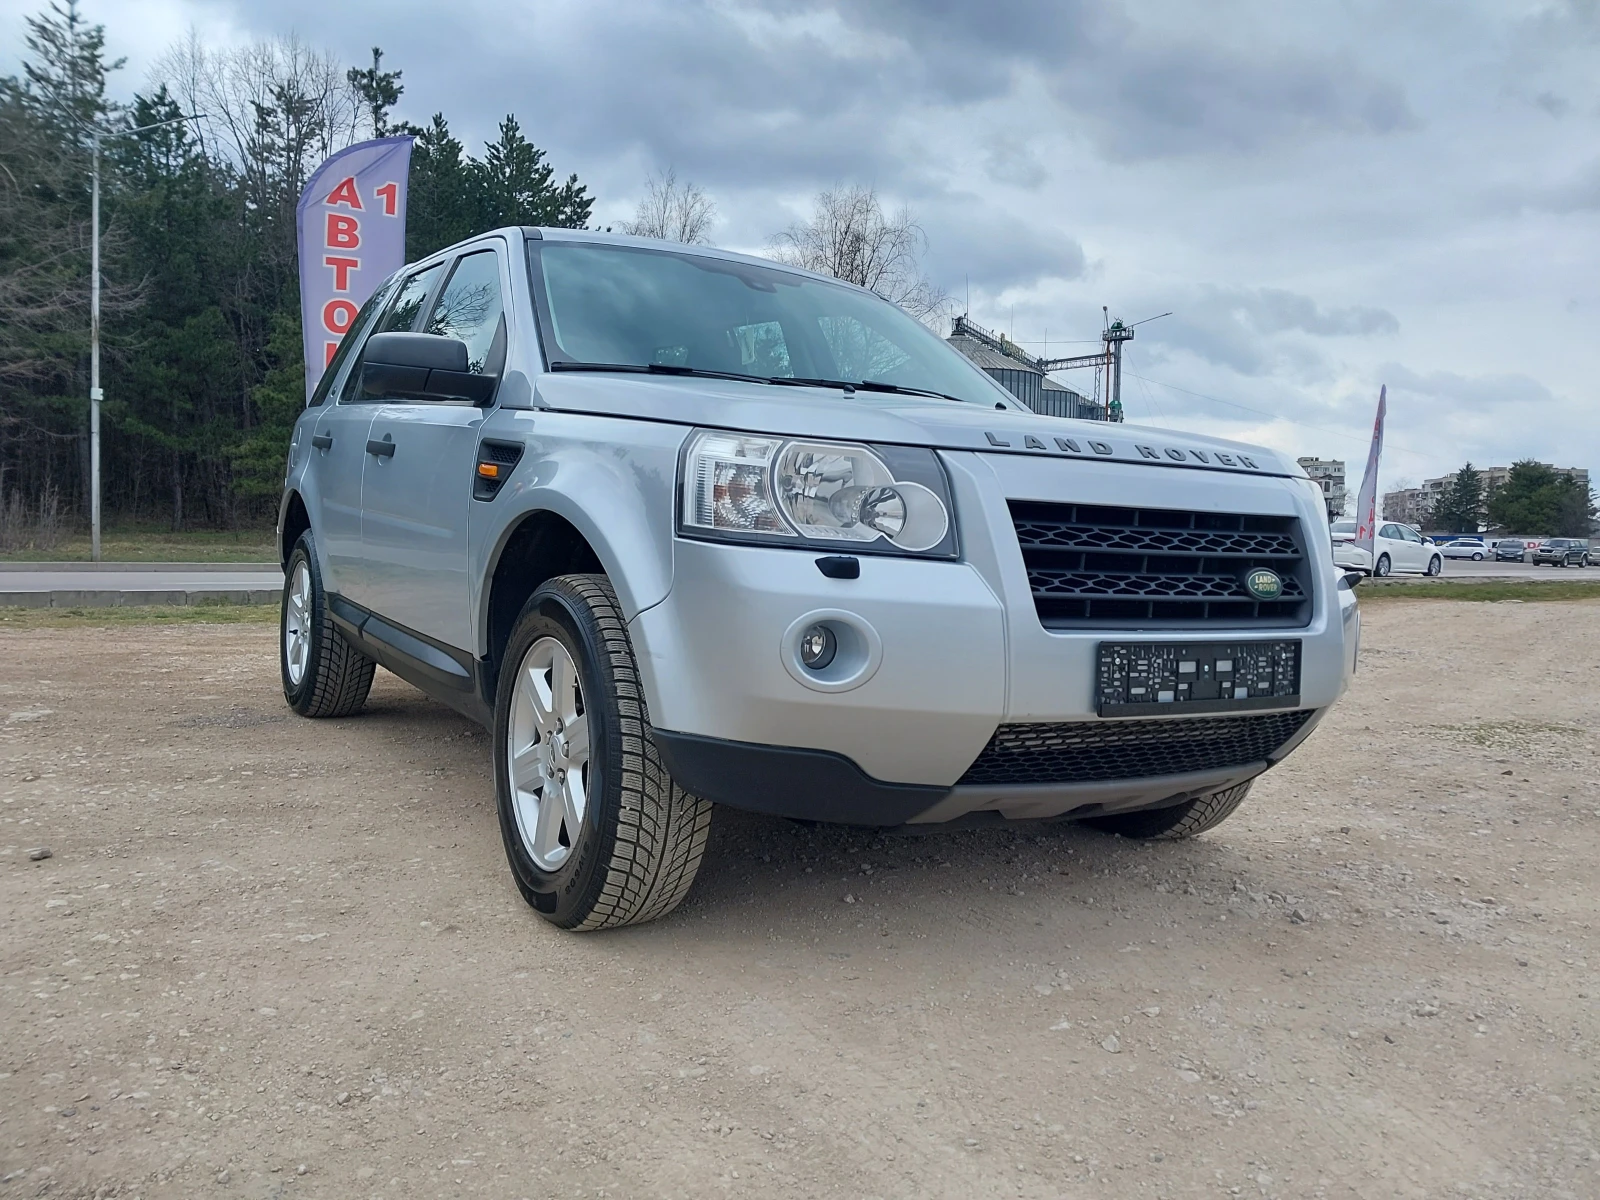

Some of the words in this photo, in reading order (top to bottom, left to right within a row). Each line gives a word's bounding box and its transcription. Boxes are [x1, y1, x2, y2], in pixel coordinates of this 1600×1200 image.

[375, 182, 398, 216] 1
[323, 176, 364, 369] АВТО
[984, 431, 1113, 456] LAND
[1134, 444, 1260, 470] ROVER
[1255, 575, 1272, 584] LAND
[1258, 583, 1278, 592] ROVER
